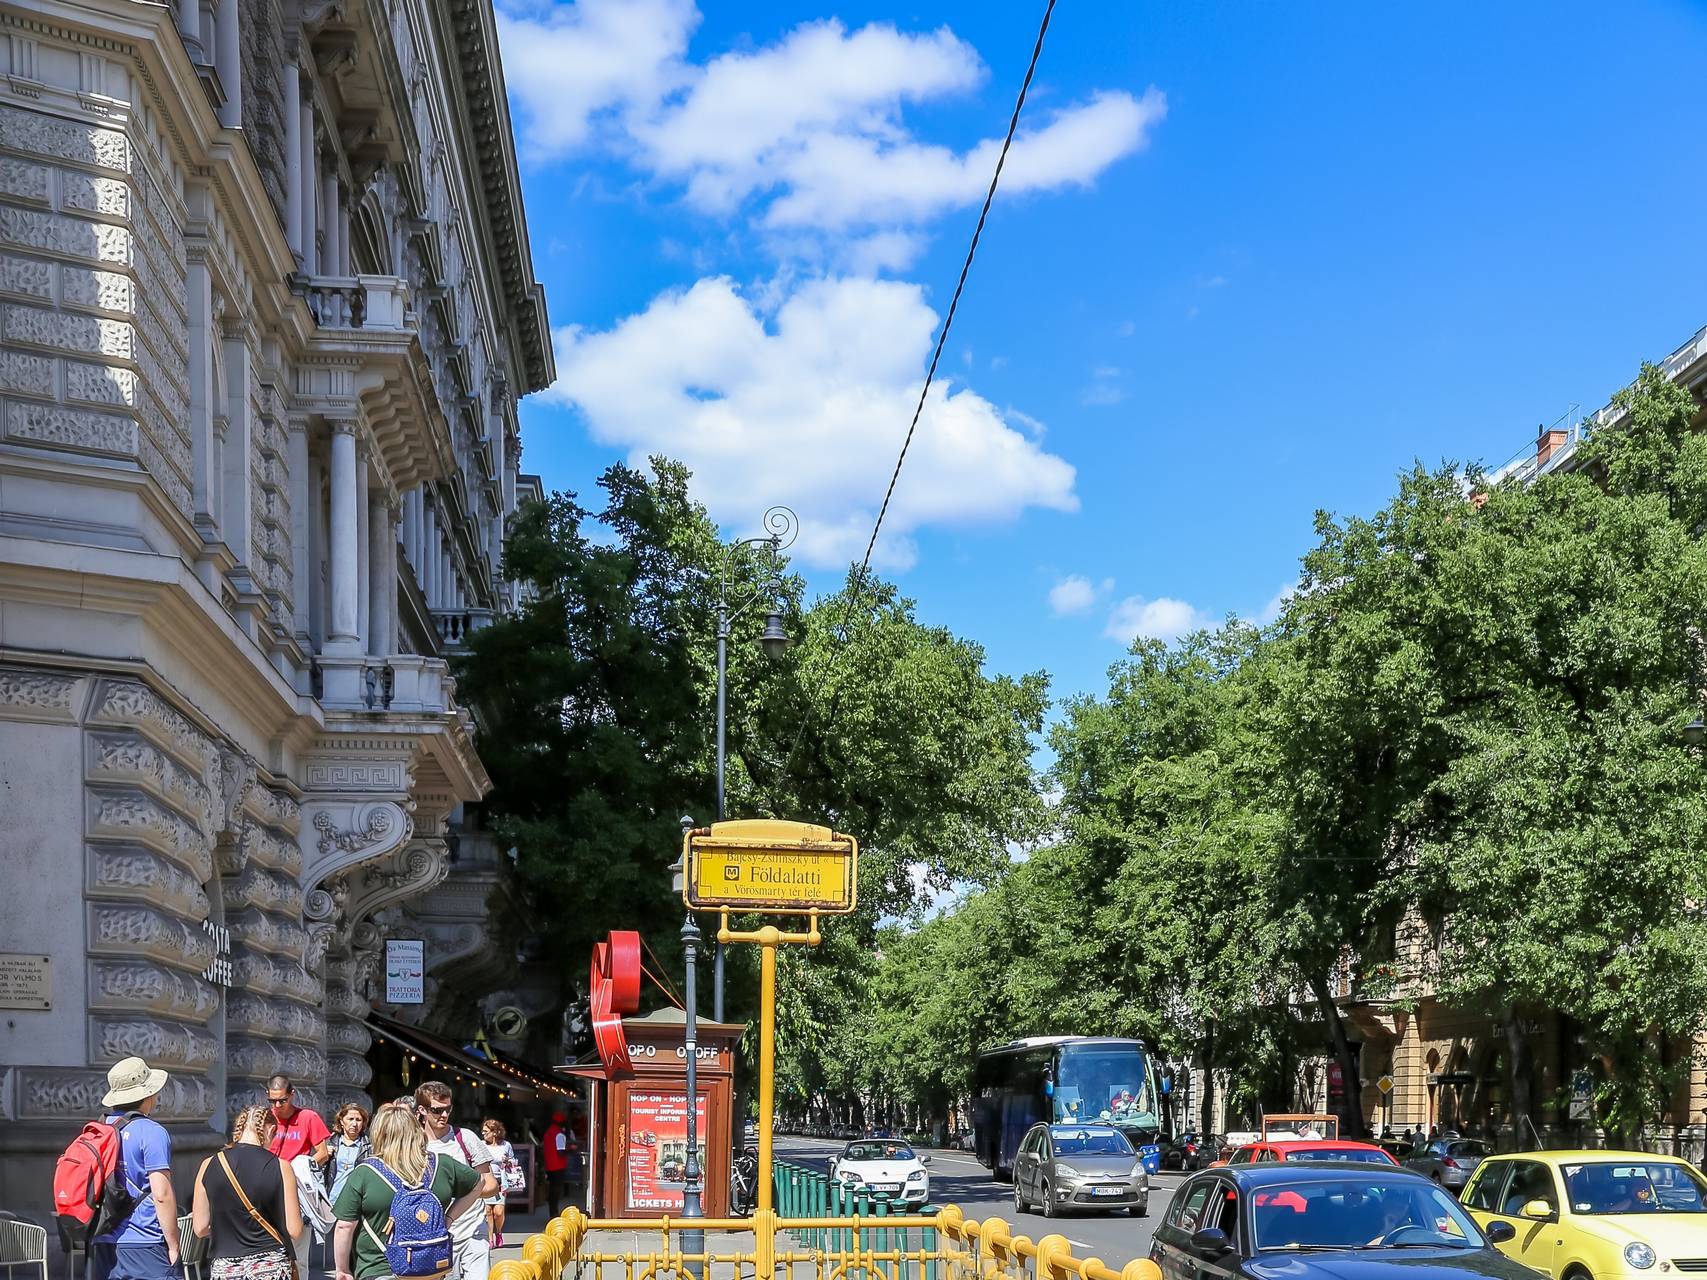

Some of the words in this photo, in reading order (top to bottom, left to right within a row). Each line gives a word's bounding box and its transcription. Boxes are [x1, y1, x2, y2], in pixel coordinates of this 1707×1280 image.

[727, 851, 809, 866] Bajcsy-Zsilinszky
[750, 866, 820, 885] Földalatti
[723, 886, 729, 894] a
[735, 884, 787, 898] Vörösmarty
[789, 885, 801, 896] tér
[804, 886, 821, 898] felé
[626, 1044, 645, 1056] OP
[695, 1047, 718, 1059] OFF
[669, 1095, 687, 1103] HOP
